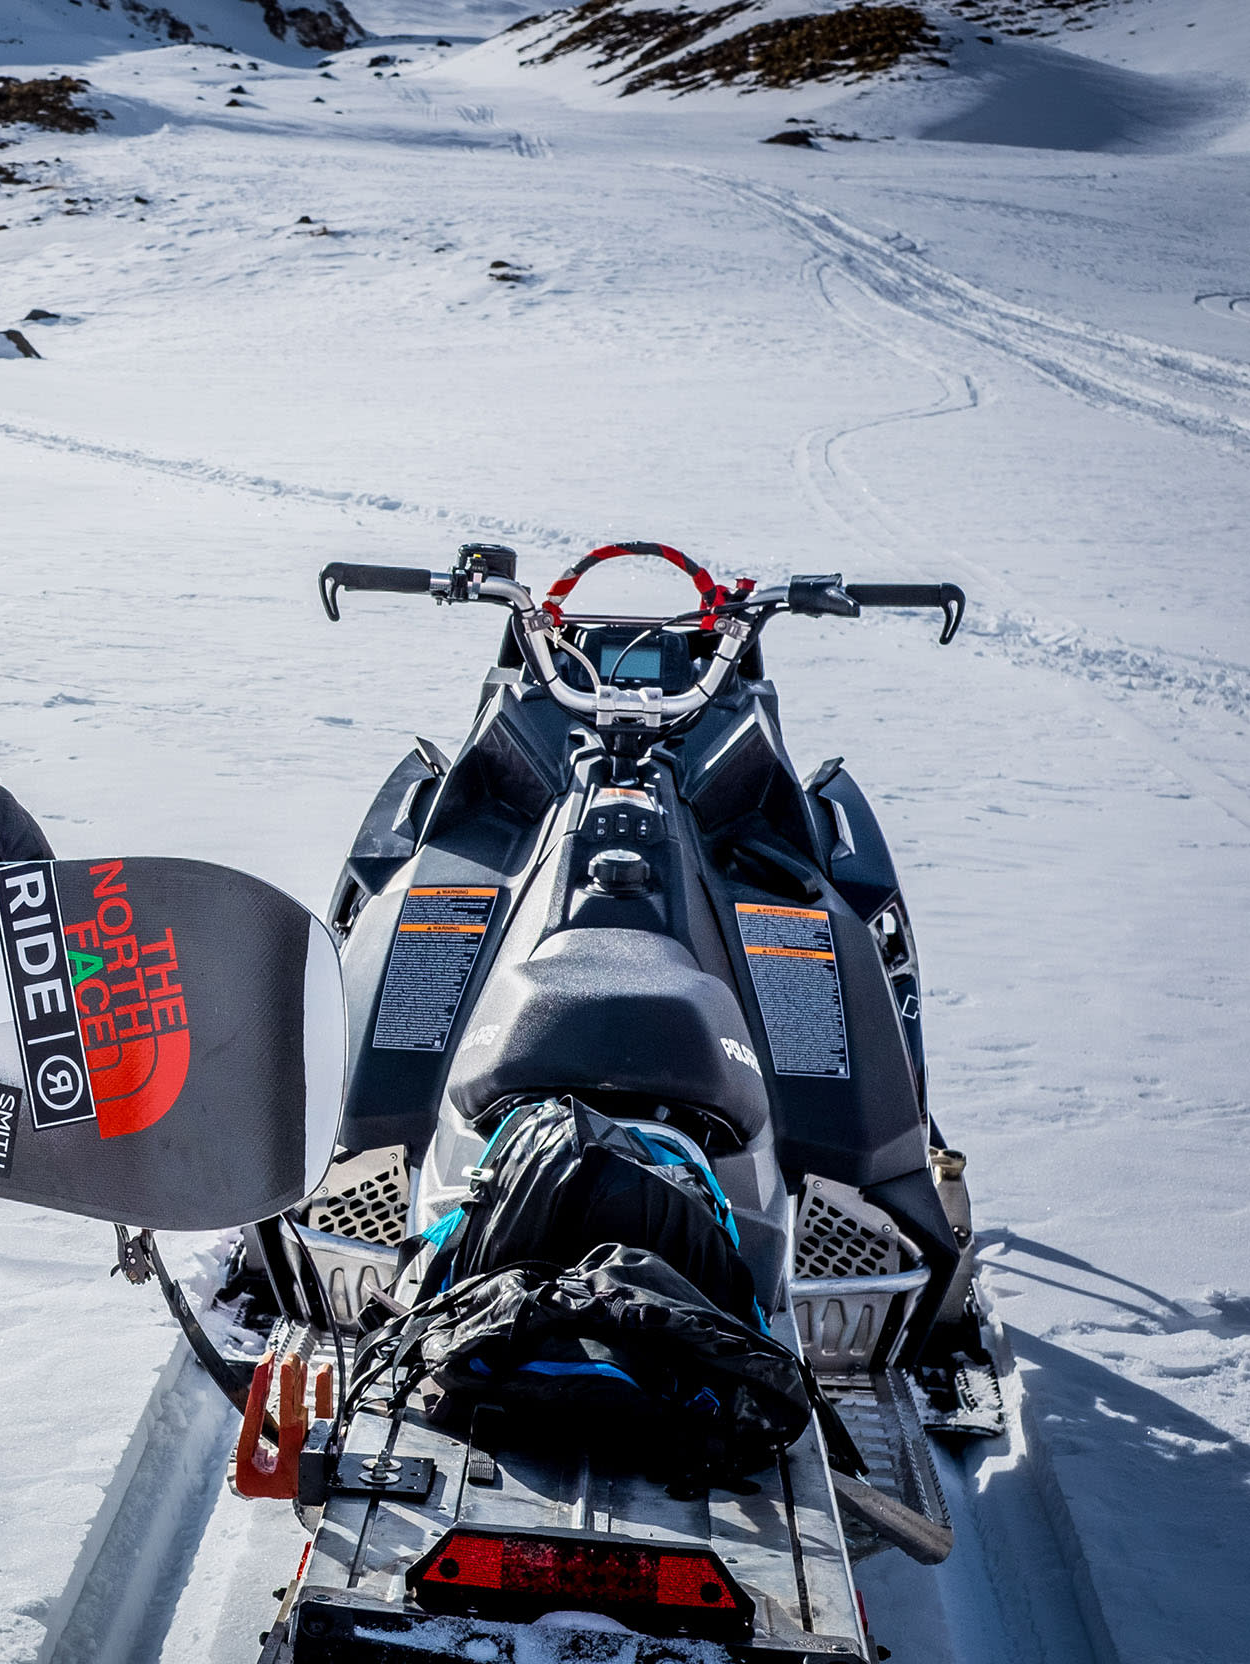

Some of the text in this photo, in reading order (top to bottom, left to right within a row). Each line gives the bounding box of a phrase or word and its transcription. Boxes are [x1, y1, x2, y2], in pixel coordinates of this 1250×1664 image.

[4, 870, 67, 1021] RIDE
[63, 919, 117, 1047] FACE
[89, 859, 153, 1039] NORTH
[140, 927, 188, 1032] THE
